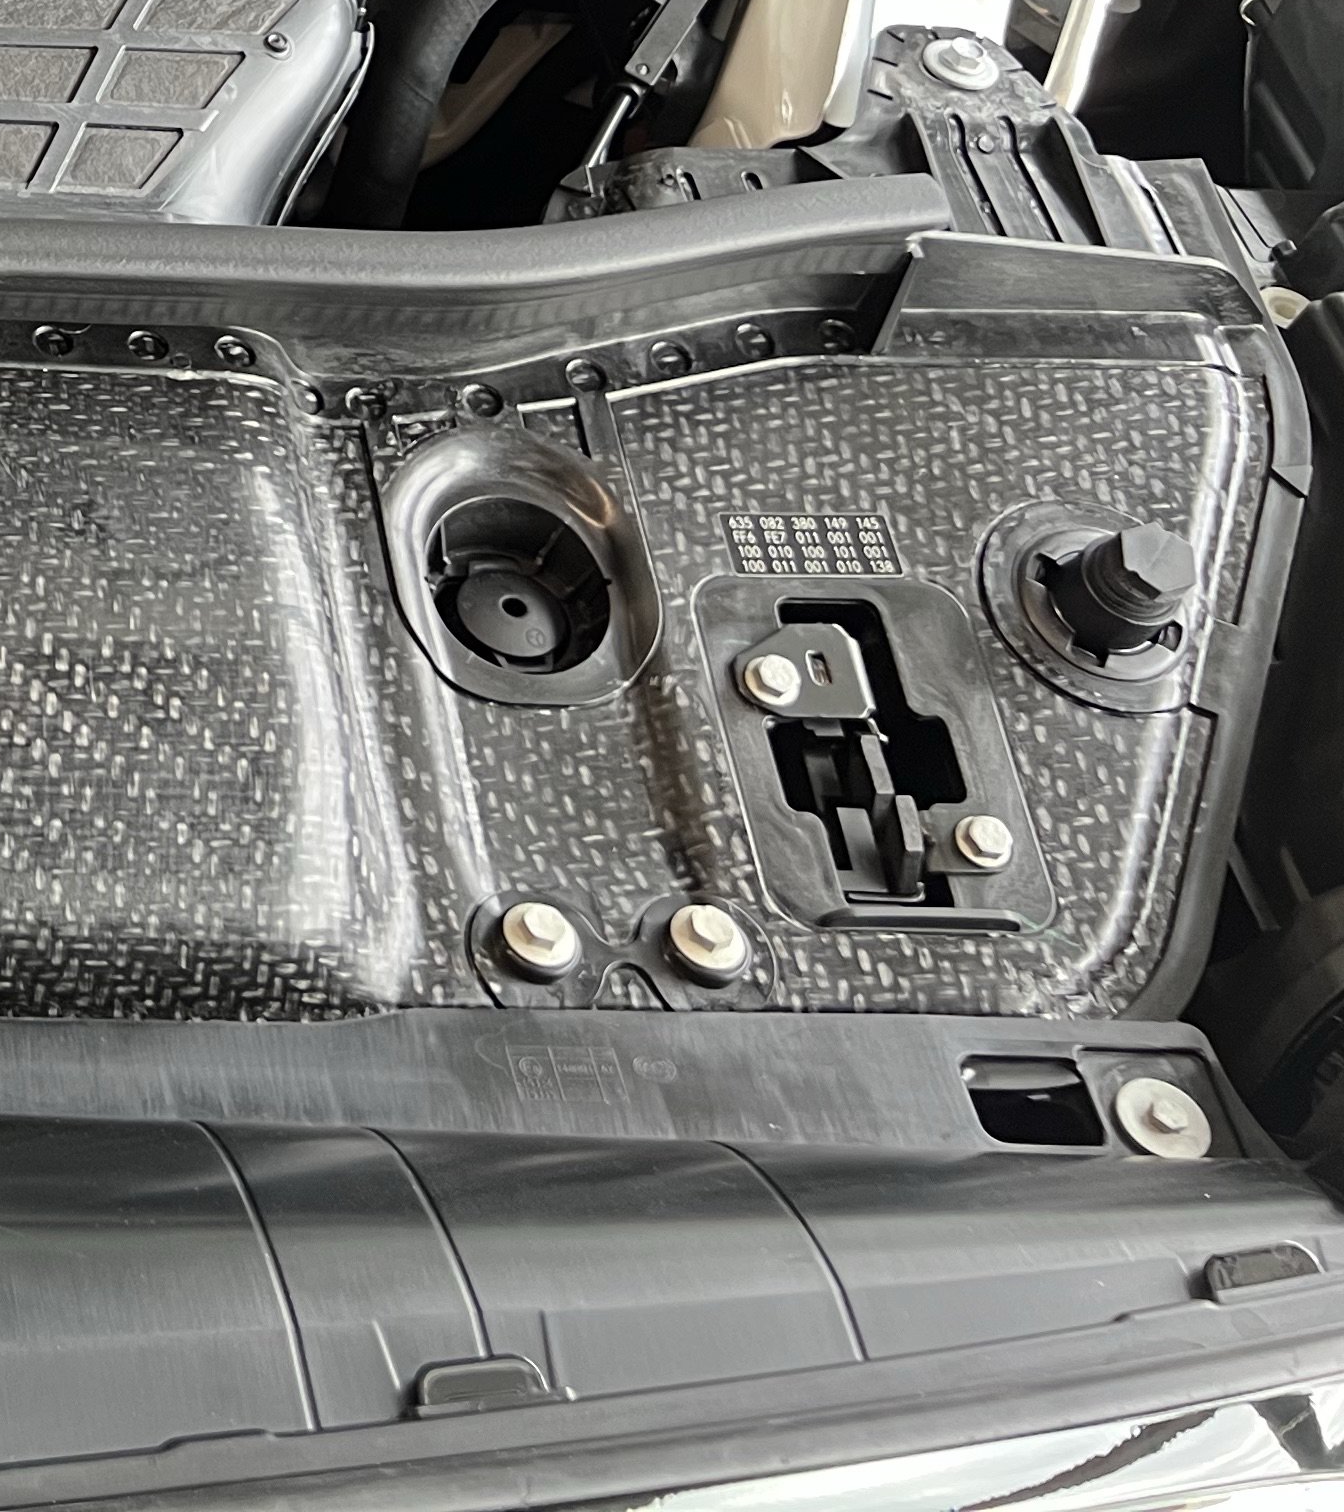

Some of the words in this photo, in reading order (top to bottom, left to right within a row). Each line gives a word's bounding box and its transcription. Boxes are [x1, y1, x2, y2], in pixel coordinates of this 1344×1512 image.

[728, 515, 753, 529] 635
[759, 516, 785, 530] 082
[790, 516, 816, 530] 380
[824, 517, 848, 530] 149
[856, 517, 880, 530] 145
[732, 530, 756, 544] FF6
[764, 530, 786, 544] FE7
[795, 531, 820, 544] 011
[827, 531, 853, 544] 001
[859, 531, 884, 544] 001
[738, 545, 762, 558] 100
[768, 545, 794, 558] 010
[801, 545, 825, 559] 100
[833, 545, 857, 558] 101
[863, 545, 889, 559] 001
[742, 559, 766, 573] 100
[772, 559, 797, 573] 011
[804, 560, 829, 573] 001
[836, 560, 863, 573] 010
[870, 560, 895, 573] 138
